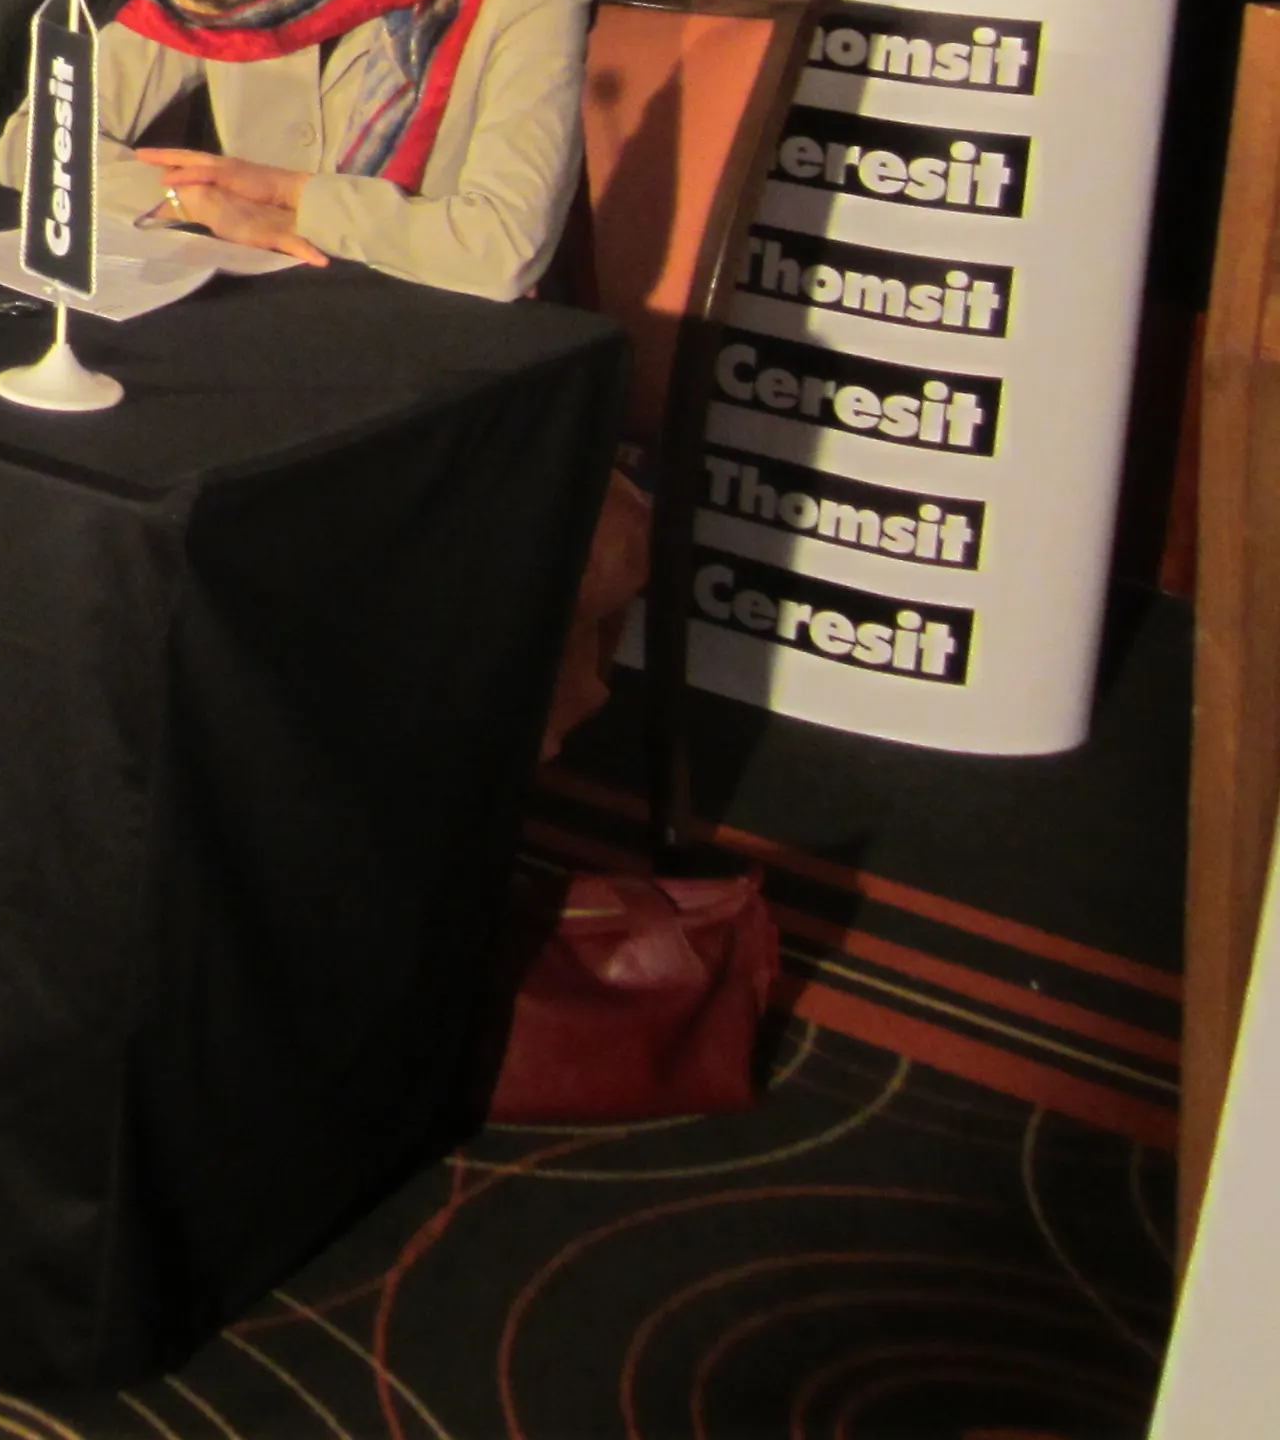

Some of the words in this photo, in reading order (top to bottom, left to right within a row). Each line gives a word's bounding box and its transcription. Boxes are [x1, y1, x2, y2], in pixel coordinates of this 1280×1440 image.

[45, 56, 75, 257] Ceresit
[779, 134, 1010, 209] eresit
[715, 343, 982, 447] Ceresit
[705, 455, 971, 562] Thomsit
[693, 564, 954, 675] Ceresit
